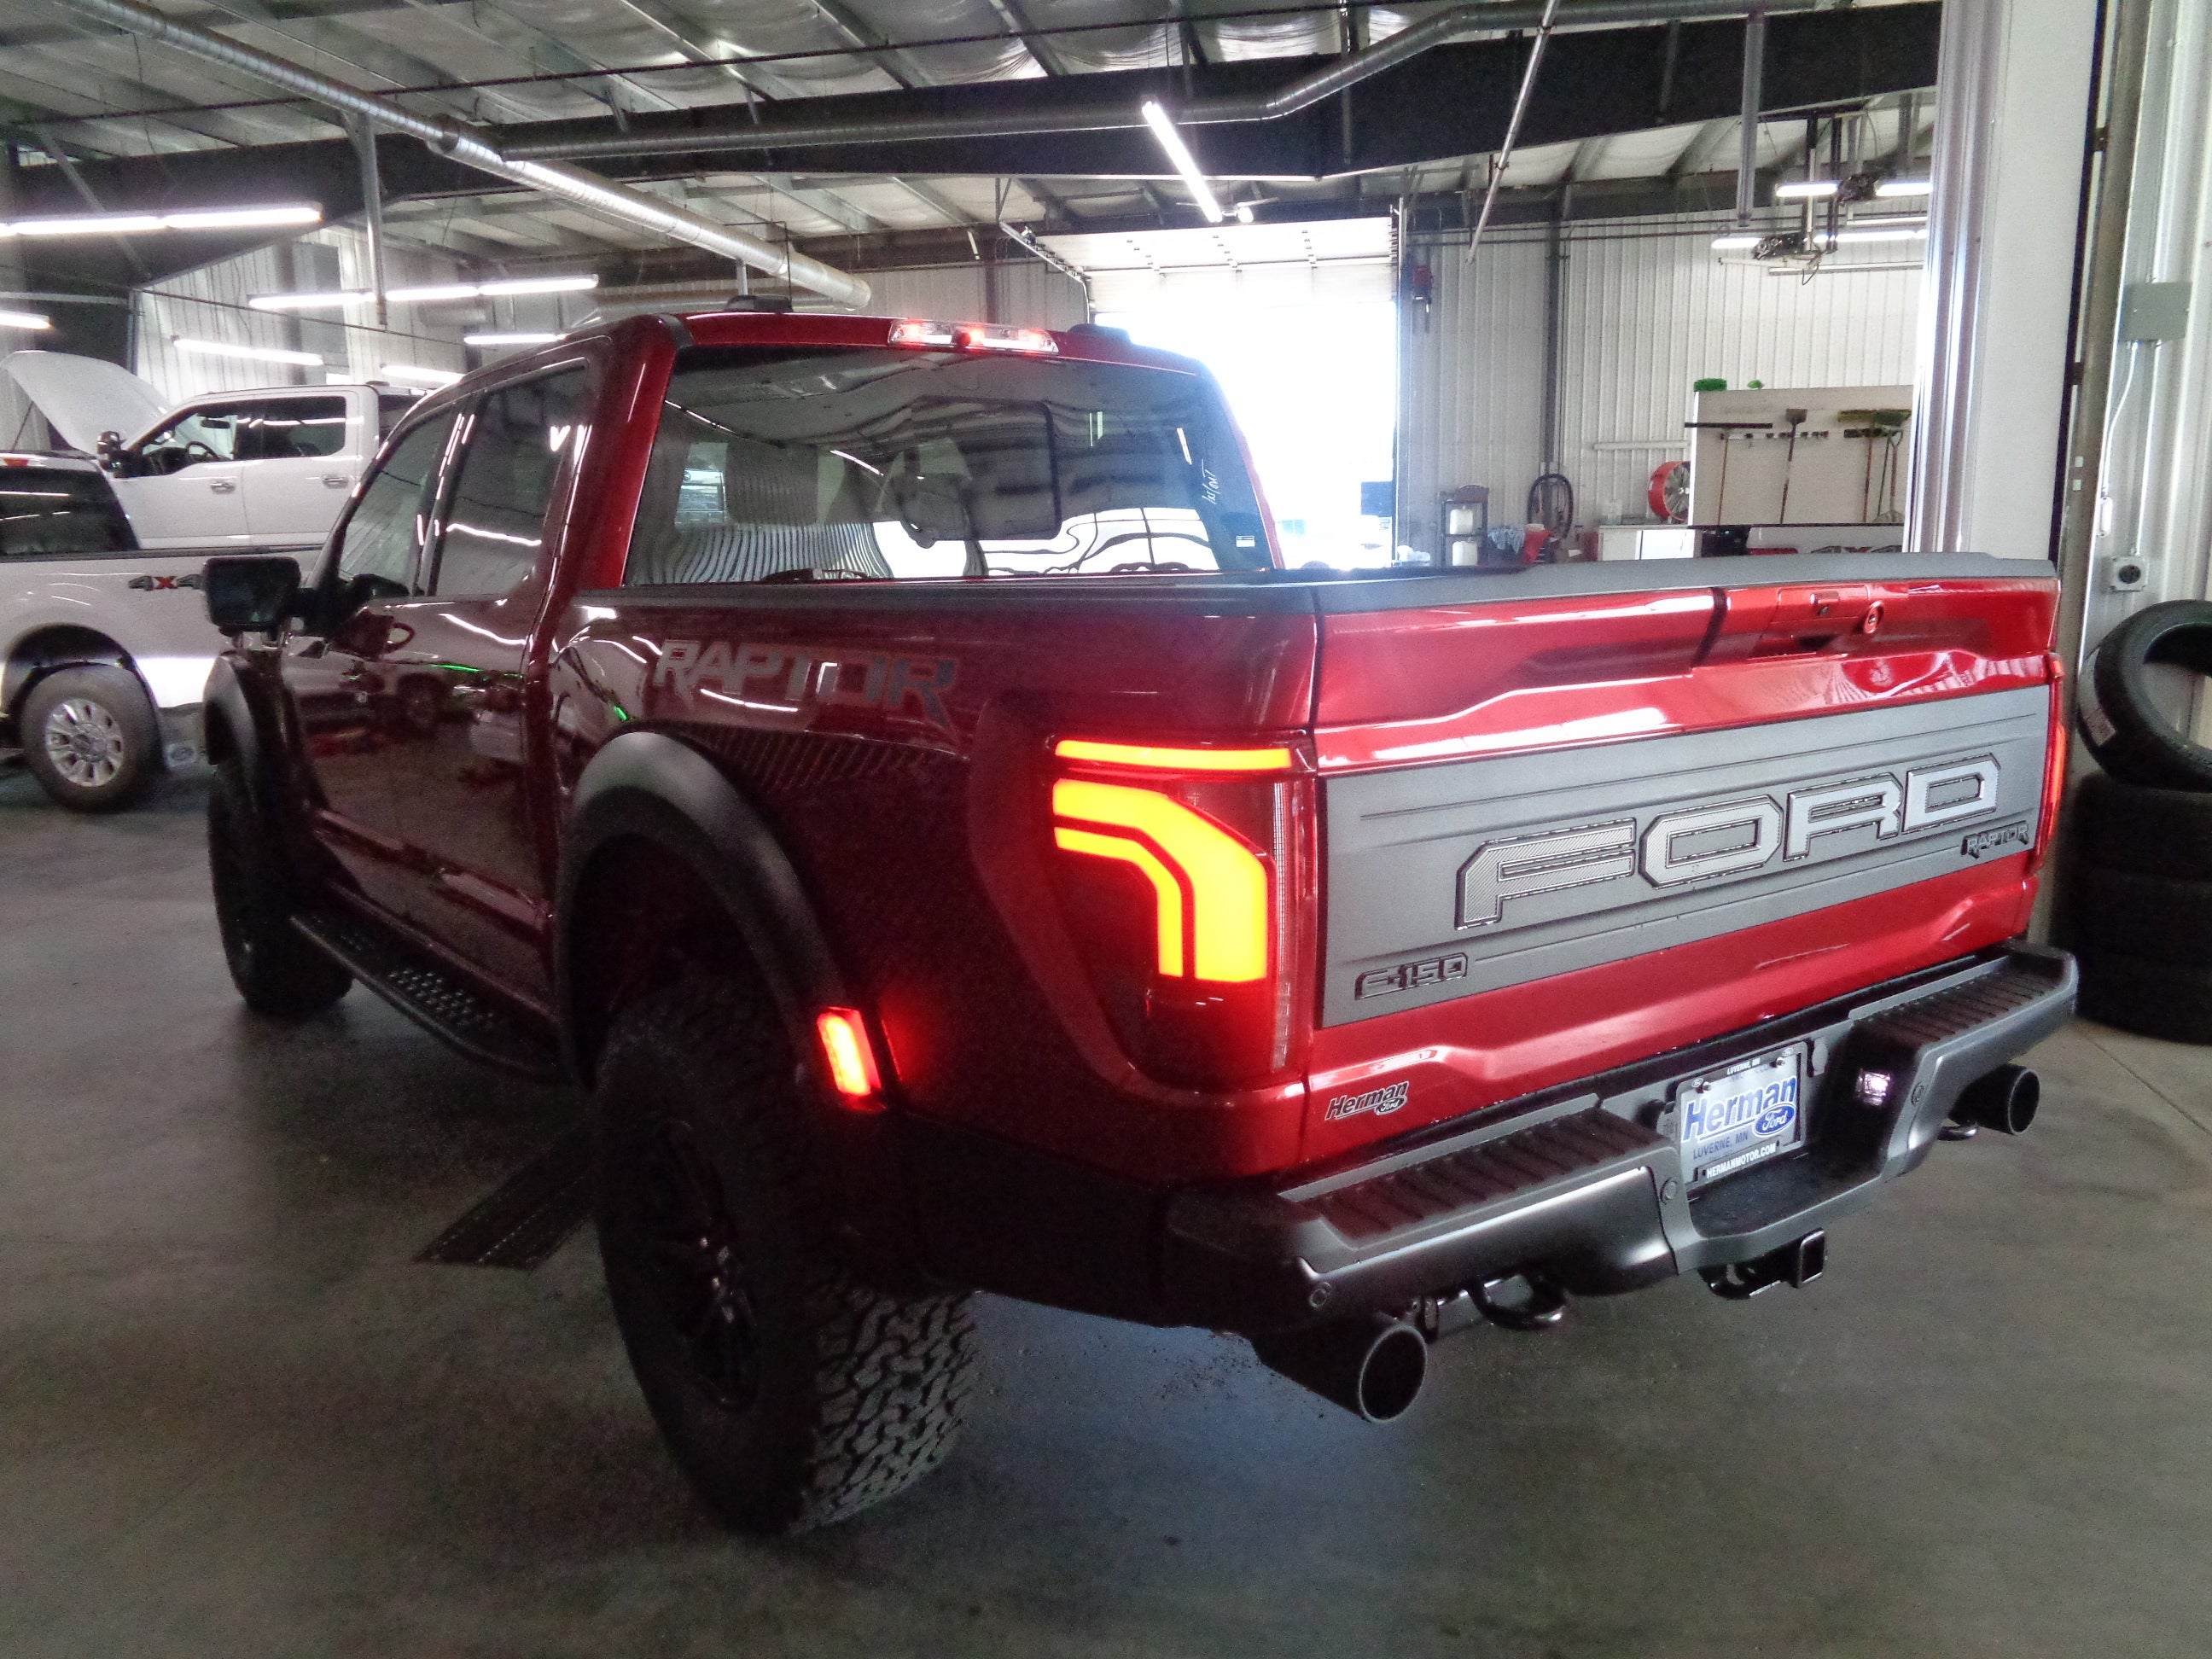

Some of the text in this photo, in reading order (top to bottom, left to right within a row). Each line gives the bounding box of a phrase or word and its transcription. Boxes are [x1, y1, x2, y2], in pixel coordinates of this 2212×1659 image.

[652, 637, 962, 741] RAPTOR
[1454, 752, 2000, 931] FORD
[1960, 820, 2029, 859] RAPTOR
[1354, 952, 1469, 1001] F-150
[1325, 1081, 1409, 1121] Herman
[1380, 1097, 1402, 1113] Ford
[1682, 1077, 1797, 1143] Herman
[1761, 1108, 1789, 1132] Ford
[1735, 1132, 1749, 1145] MN
[1707, 1142, 1776, 1179] HERMANMOTOR.COM
